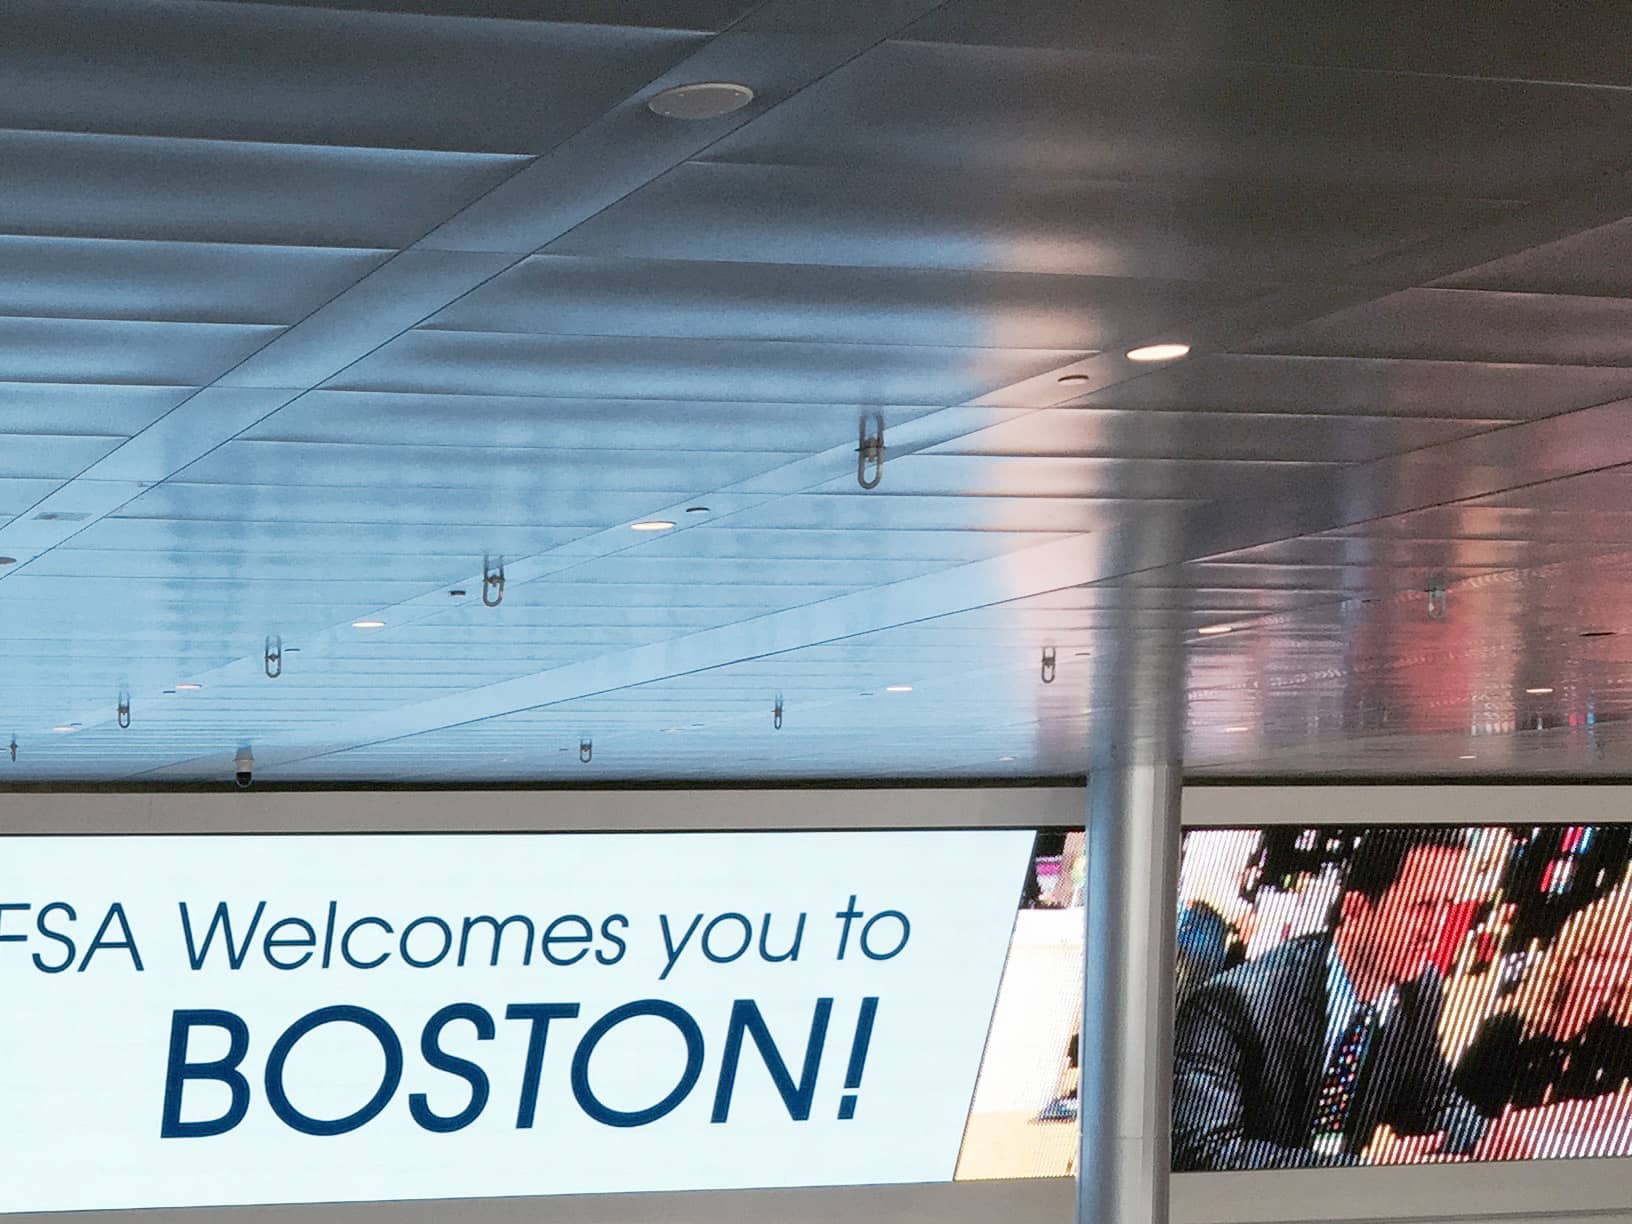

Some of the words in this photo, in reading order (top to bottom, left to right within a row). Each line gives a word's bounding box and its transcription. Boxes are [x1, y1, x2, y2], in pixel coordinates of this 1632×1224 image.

[178, 900, 628, 971] Welcomes
[659, 911, 804, 980] you
[836, 895, 911, 962] to
[161, 996, 879, 1139] BOSTON!
